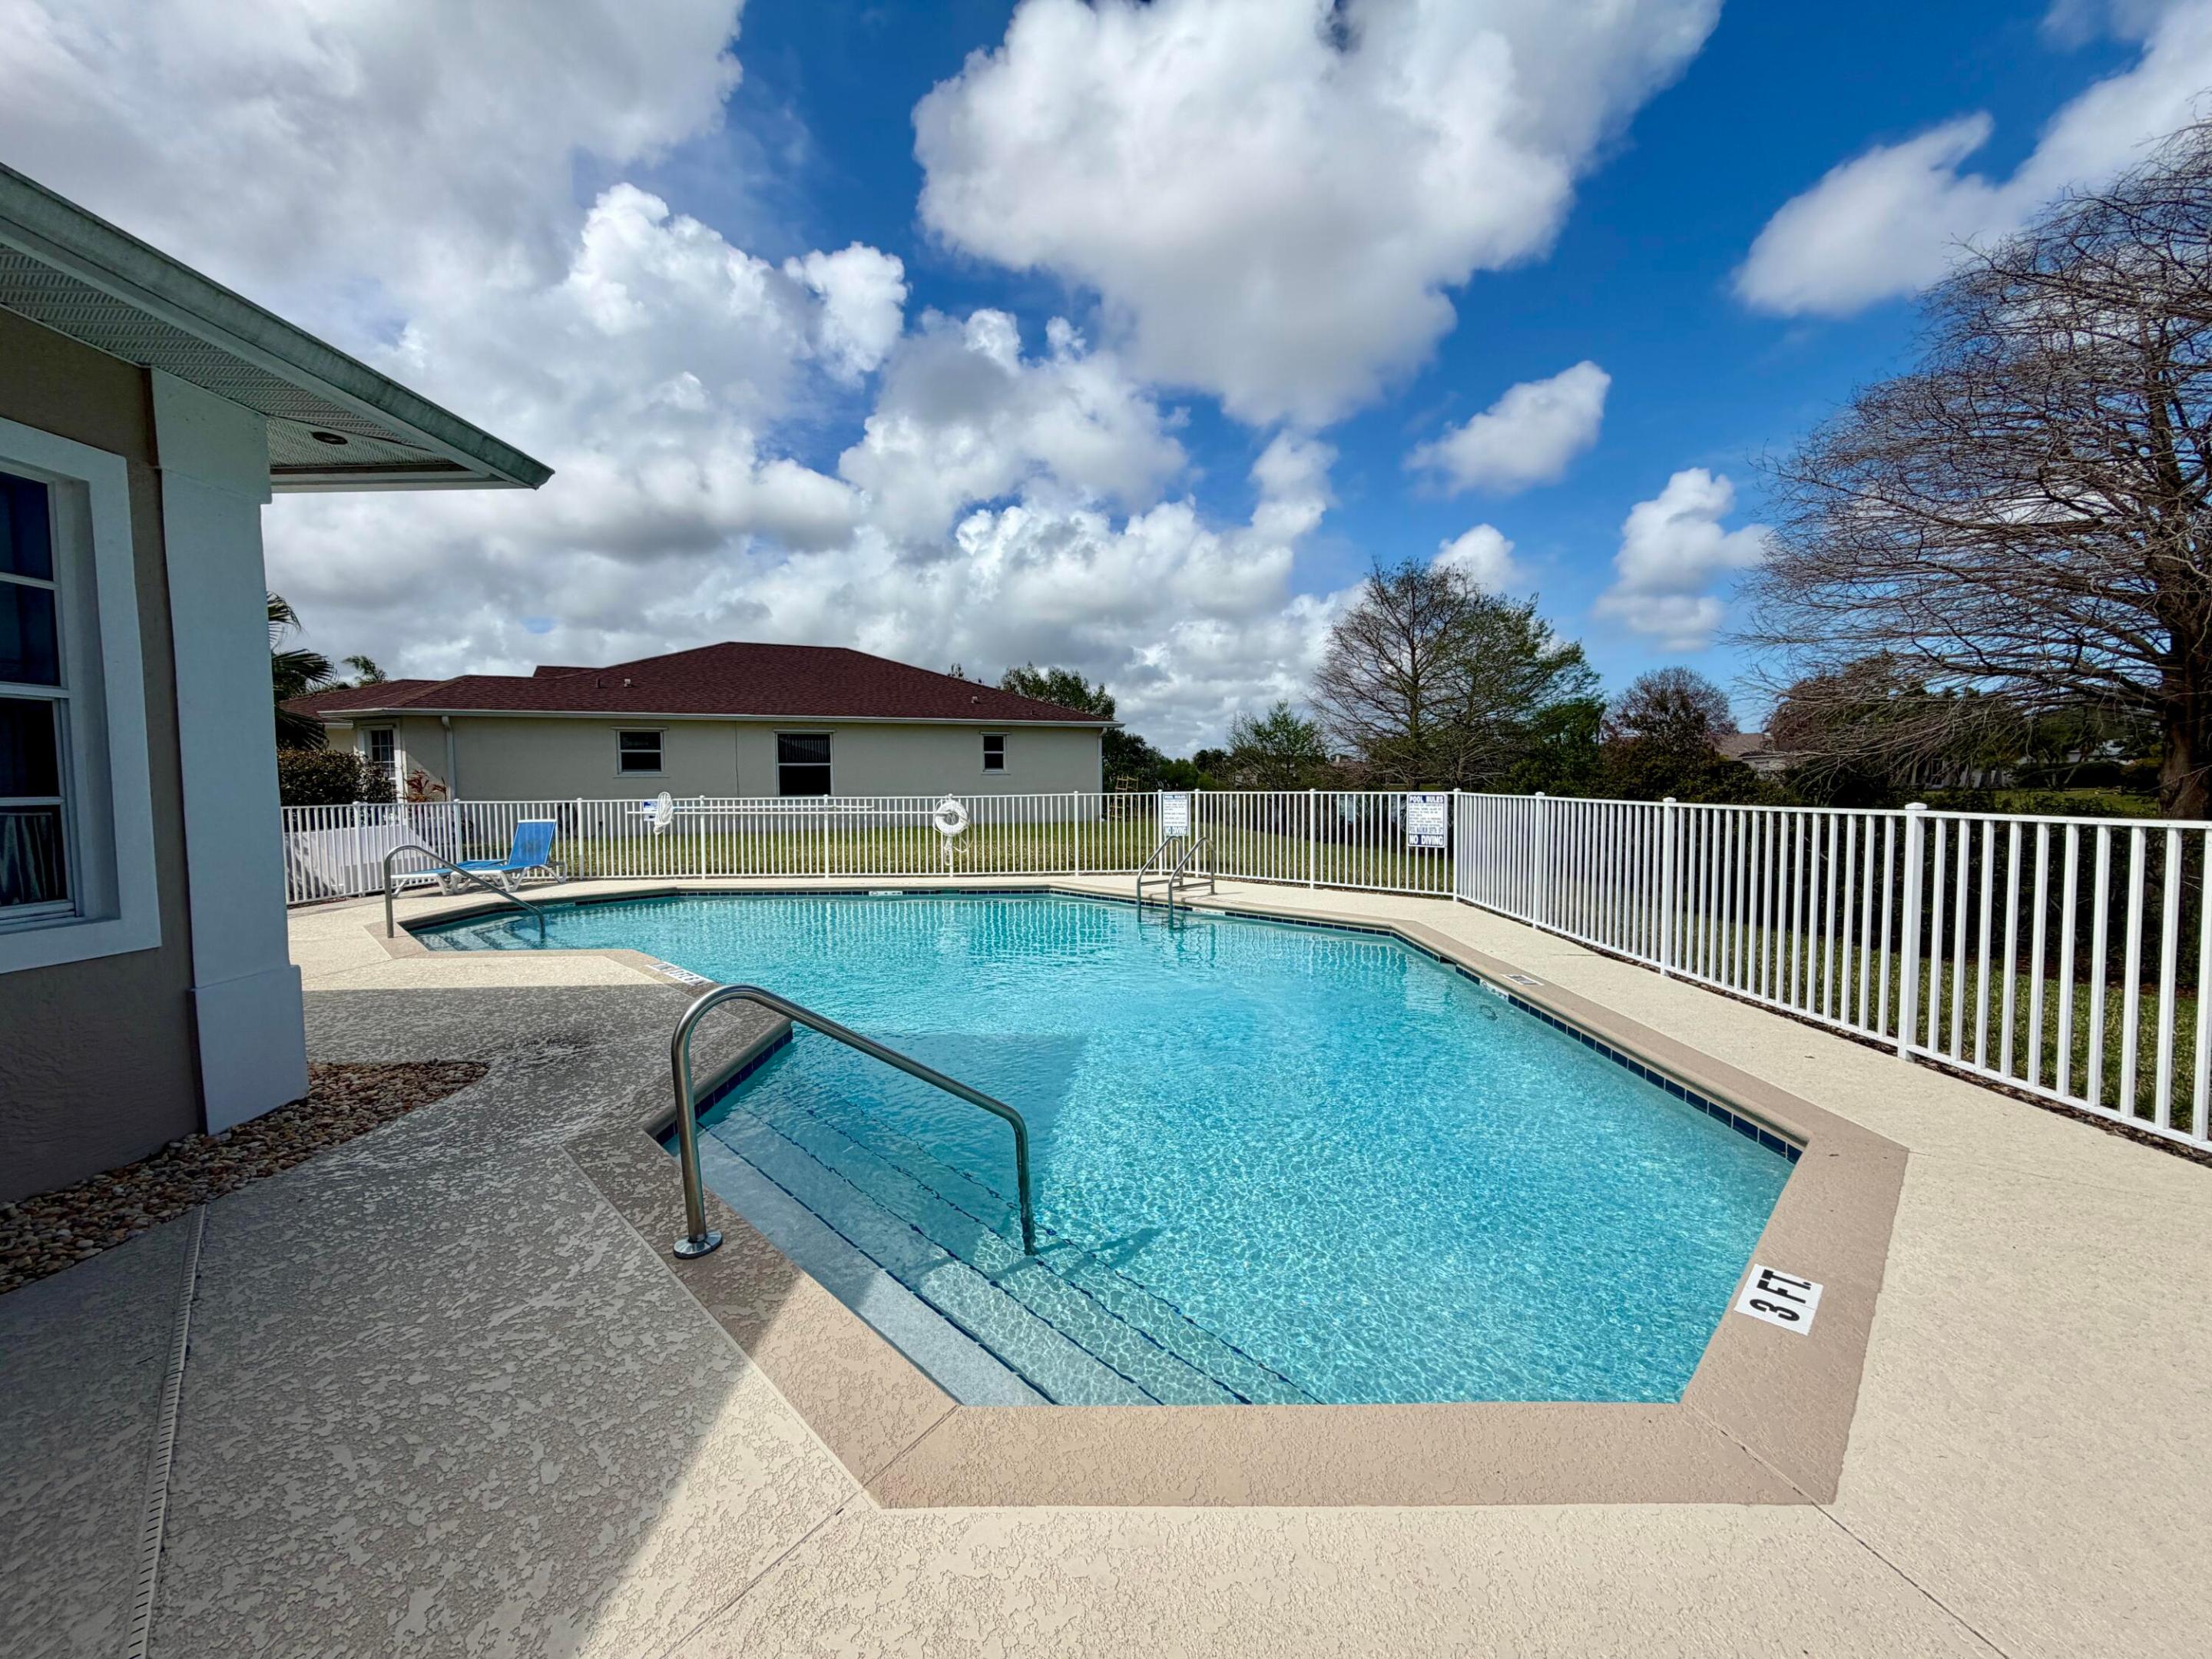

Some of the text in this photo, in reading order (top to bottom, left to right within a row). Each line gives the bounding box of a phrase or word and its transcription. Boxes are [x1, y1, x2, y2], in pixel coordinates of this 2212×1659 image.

[1164, 826, 1187, 835] NO DIVING
[1409, 835, 1443, 845] NO DIVING
[1749, 1299, 1800, 1321] 3
